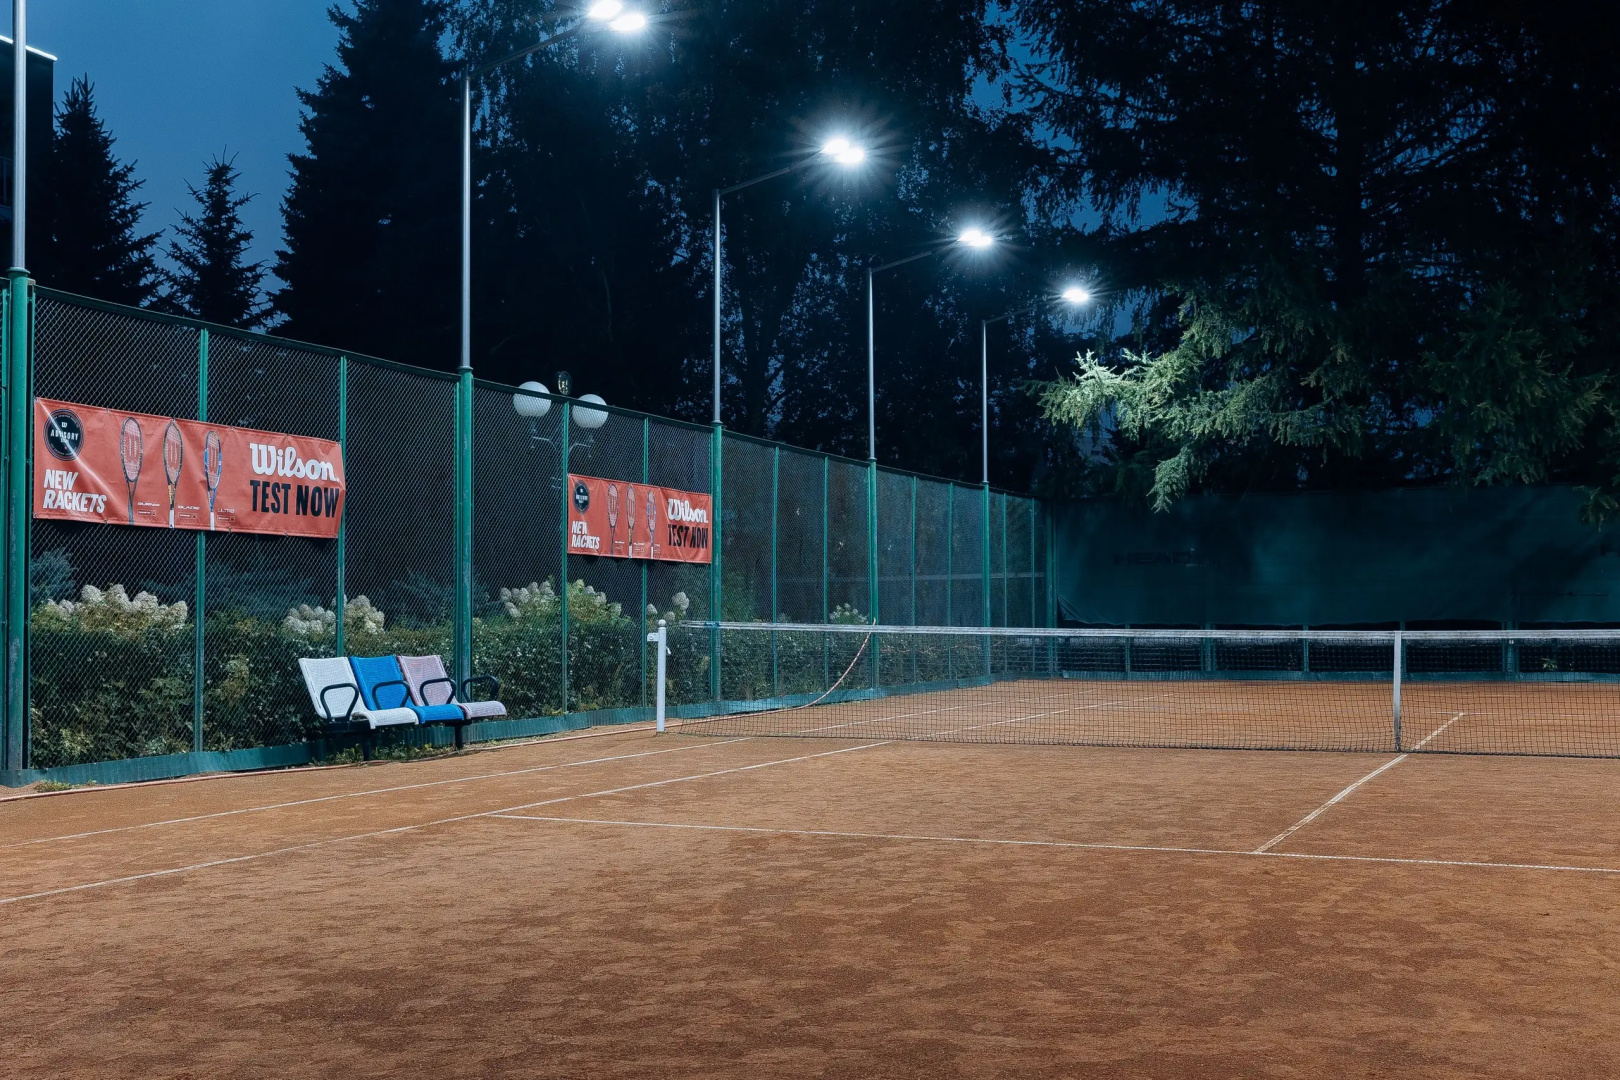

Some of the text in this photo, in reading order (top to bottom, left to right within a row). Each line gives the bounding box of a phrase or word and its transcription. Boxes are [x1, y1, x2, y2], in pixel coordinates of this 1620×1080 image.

[43, 468, 79, 491] NEW
[42, 489, 108, 514] RACKETS
[249, 479, 340, 518] TEST NOW
[667, 523, 709, 549] TEST NOW
